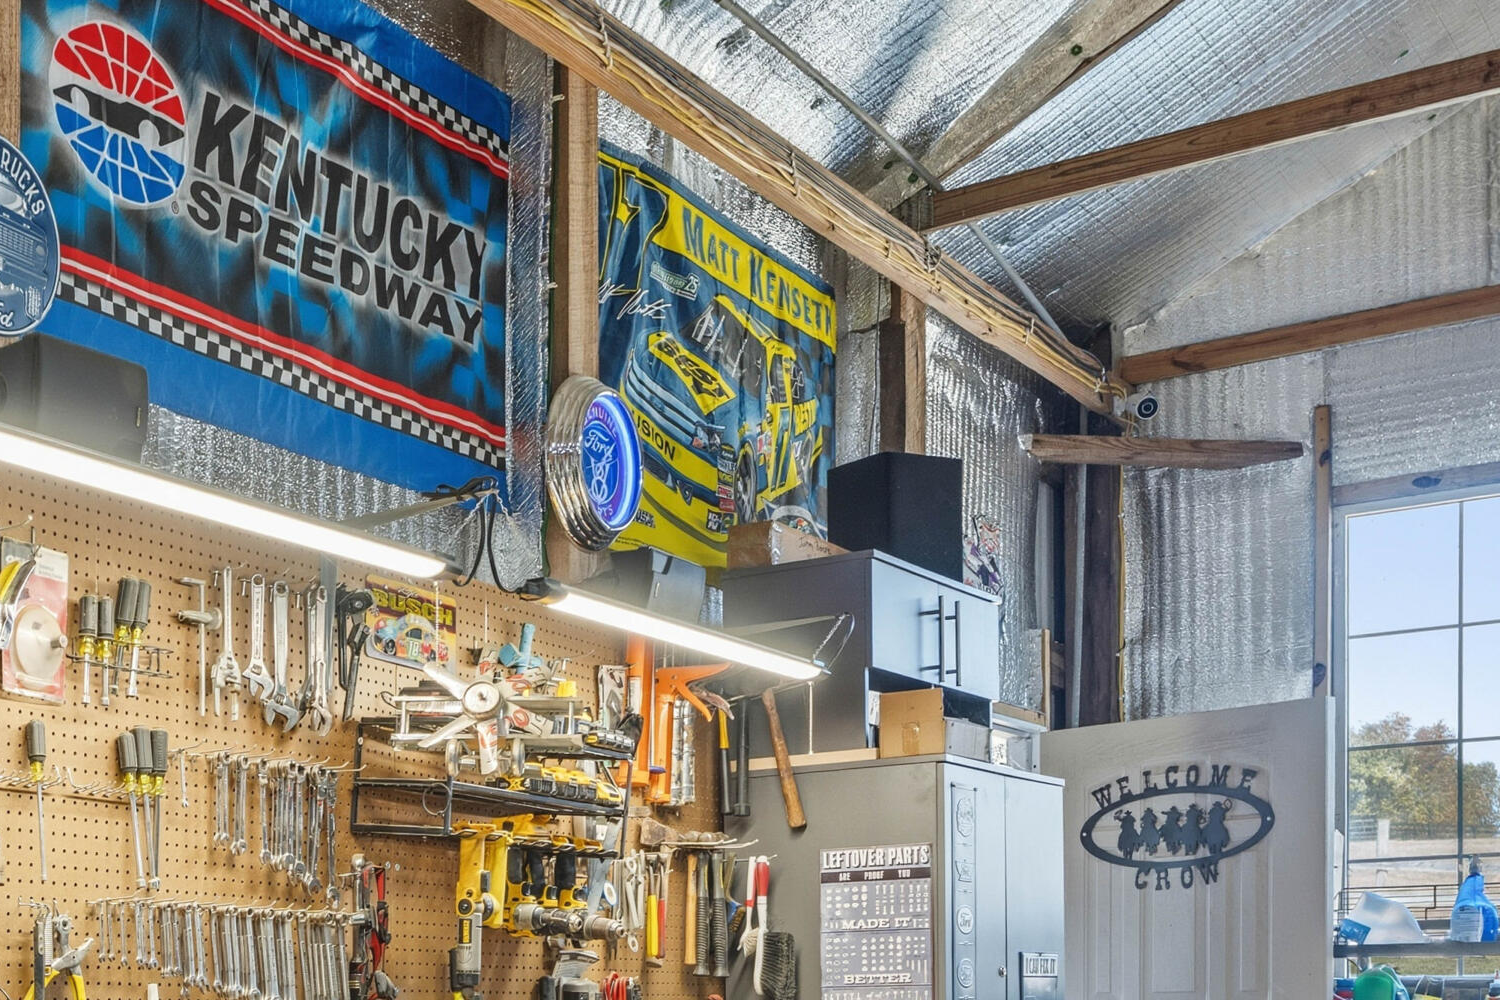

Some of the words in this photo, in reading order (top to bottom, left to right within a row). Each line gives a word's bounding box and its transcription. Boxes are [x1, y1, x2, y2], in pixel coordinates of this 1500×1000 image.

[194, 91, 487, 301] KENTUCKY
[187, 180, 482, 345] SPEEDWAY
[682, 205, 740, 284] MATT
[750, 251, 833, 331] KENSETH
[372, 588, 453, 626] BUSCH
[1091, 764, 1258, 809] WELCOME
[822, 849, 885, 870] LEFTOVER
[888, 844, 930, 866] PARTS
[839, 872, 851, 881] ARE
[864, 870, 885, 880] PROOF
[898, 869, 911, 879] YOU
[842, 918, 890, 930] MADE
[895, 917, 912, 928] IT
[843, 973, 912, 985] BETTER
[1029, 958, 1039, 974] CAN
